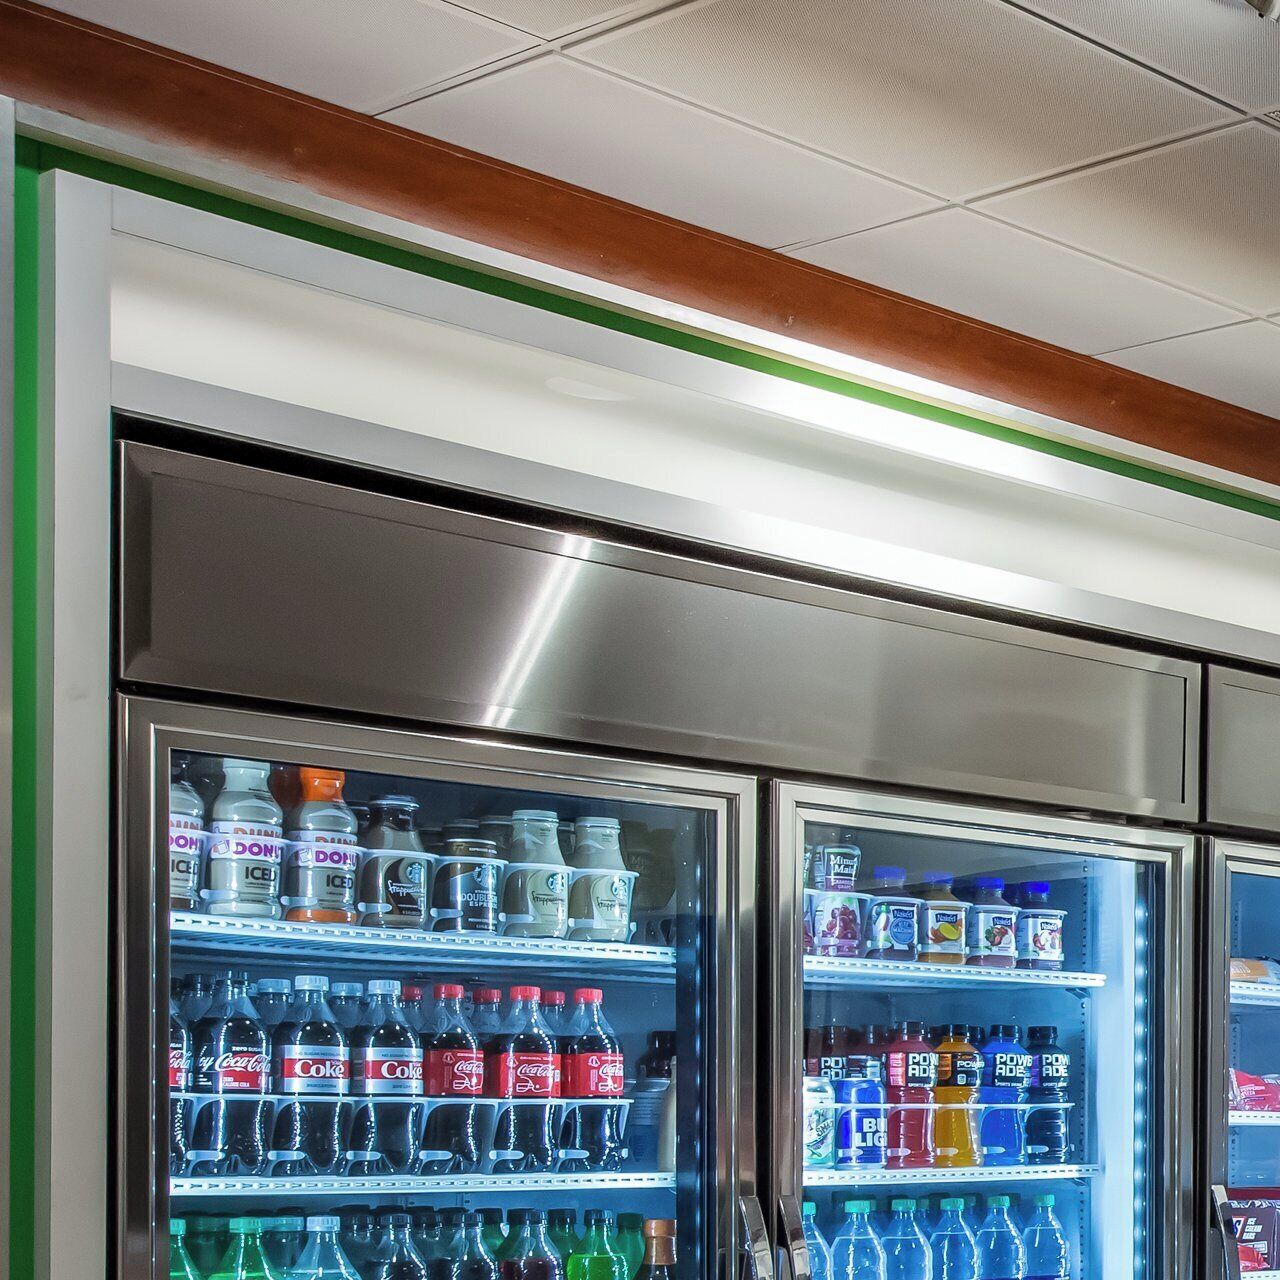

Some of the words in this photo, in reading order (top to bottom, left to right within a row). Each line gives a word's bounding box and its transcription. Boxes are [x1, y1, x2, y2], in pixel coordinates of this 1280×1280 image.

[245, 866, 277, 882] ICED
[326, 874, 354, 890] ICED
[294, 1060, 346, 1078] Coke
[381, 1061, 424, 1080] Coke
